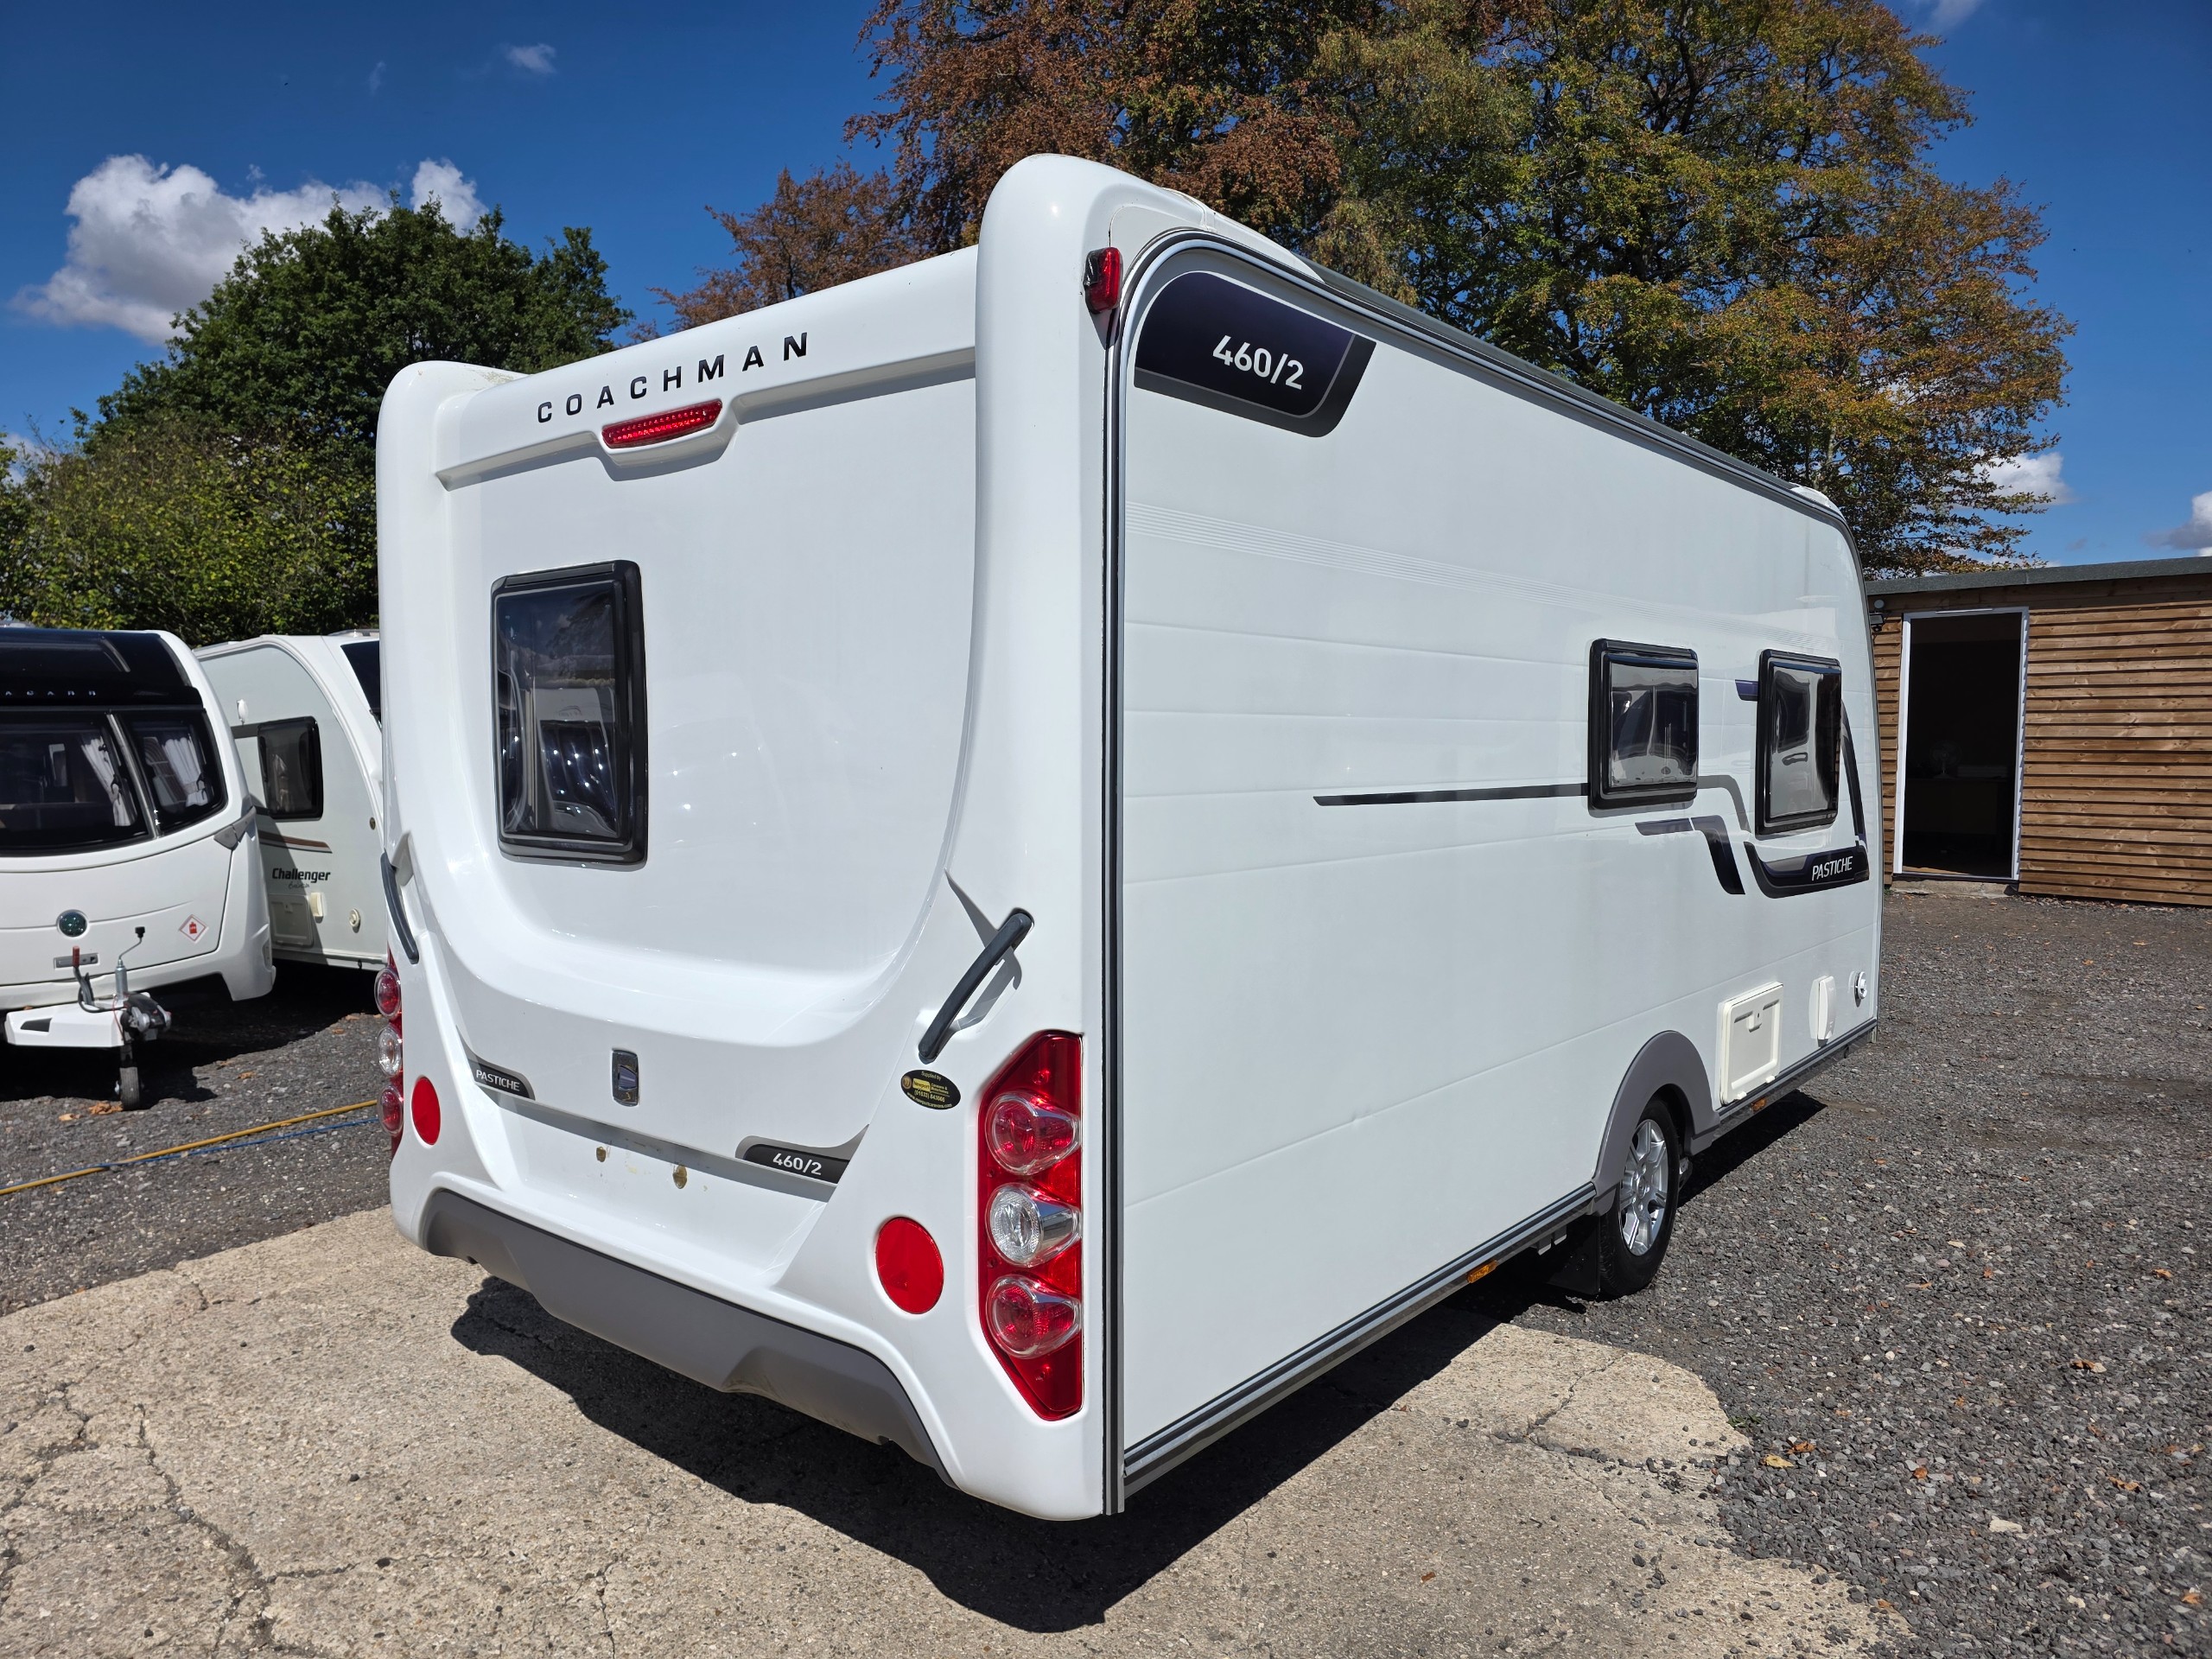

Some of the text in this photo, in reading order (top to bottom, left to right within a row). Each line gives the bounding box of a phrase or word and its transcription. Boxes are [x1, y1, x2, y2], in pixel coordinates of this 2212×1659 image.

[1212, 334, 1304, 391] 460/2
[537, 332, 808, 423] COACHMAN
[271, 868, 331, 883] Challenger
[1811, 855, 1853, 881] PASTICHE
[476, 1069, 520, 1091] PASTICHE
[913, 1080, 930, 1090] Newport
[921, 1071, 937, 1079] Supplied
[772, 1153, 822, 1176] 460/2
